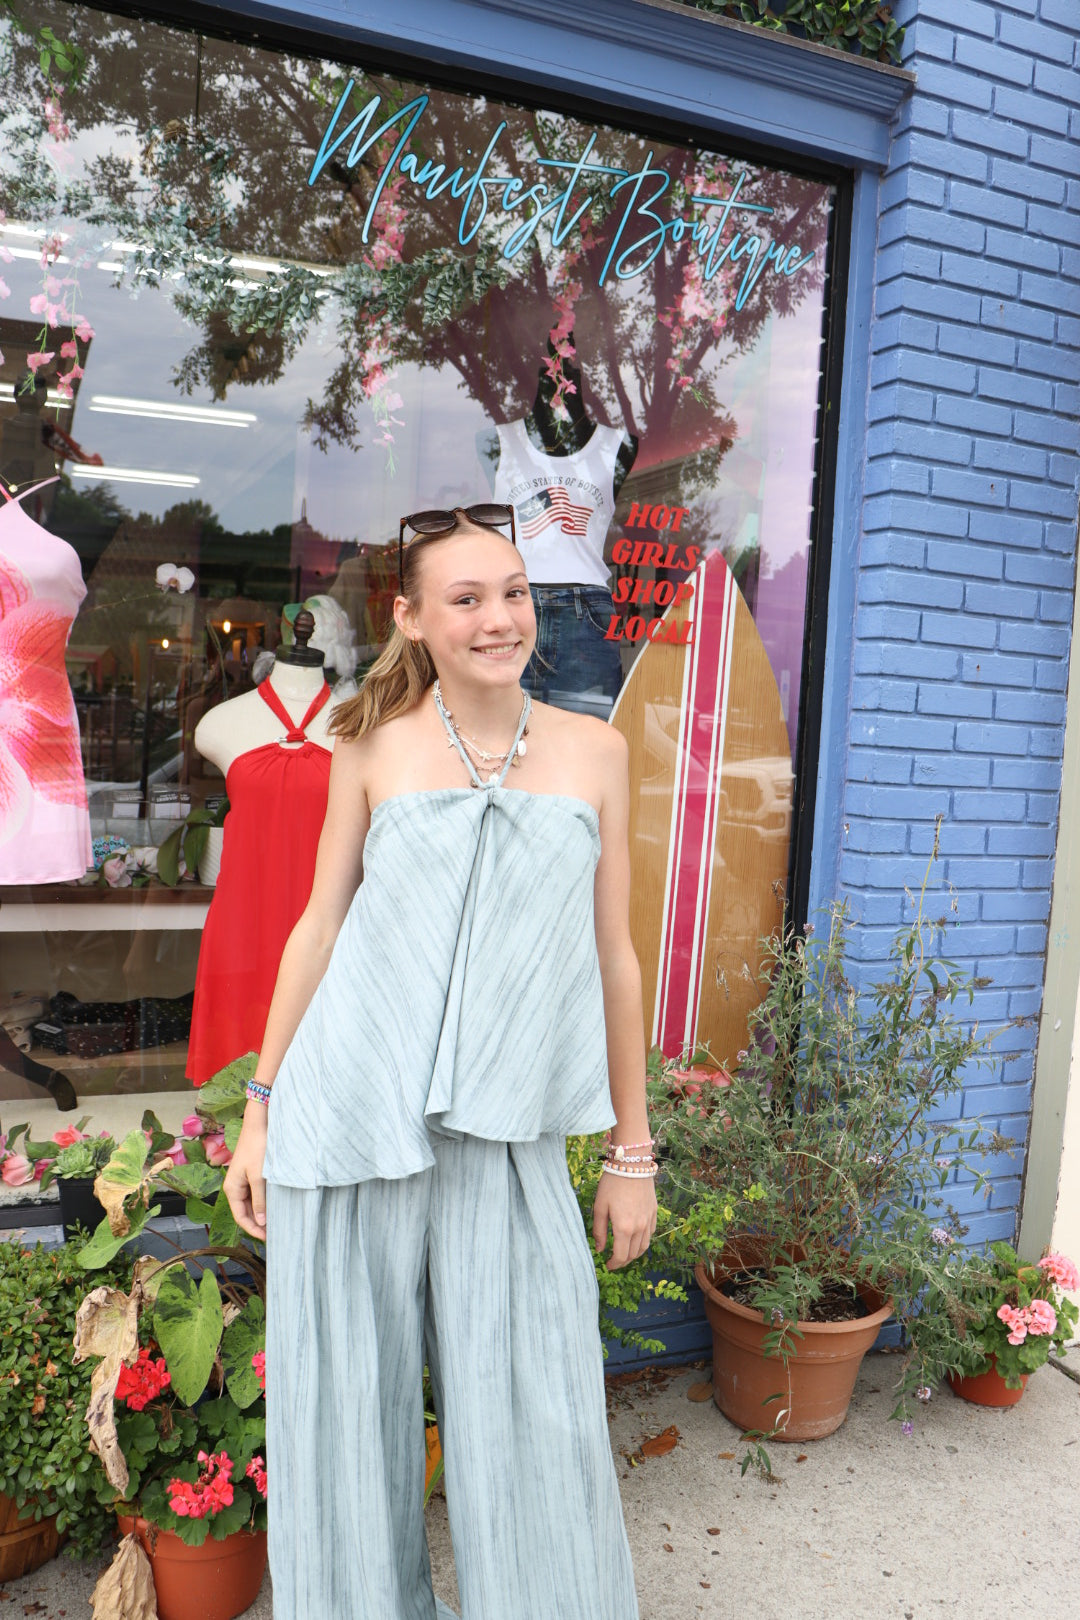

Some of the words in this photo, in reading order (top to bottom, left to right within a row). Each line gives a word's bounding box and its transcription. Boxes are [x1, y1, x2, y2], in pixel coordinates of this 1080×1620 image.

[308, 78, 629, 259] Manifest
[599, 150, 815, 311] Boutique
[532, 476, 563, 488] STATES
[565, 477, 577, 487] OF
[624, 502, 690, 532] HOT
[611, 538, 700, 571] GIRLS
[611, 577, 695, 607] SHOP
[604, 615, 696, 645] LOCAL
